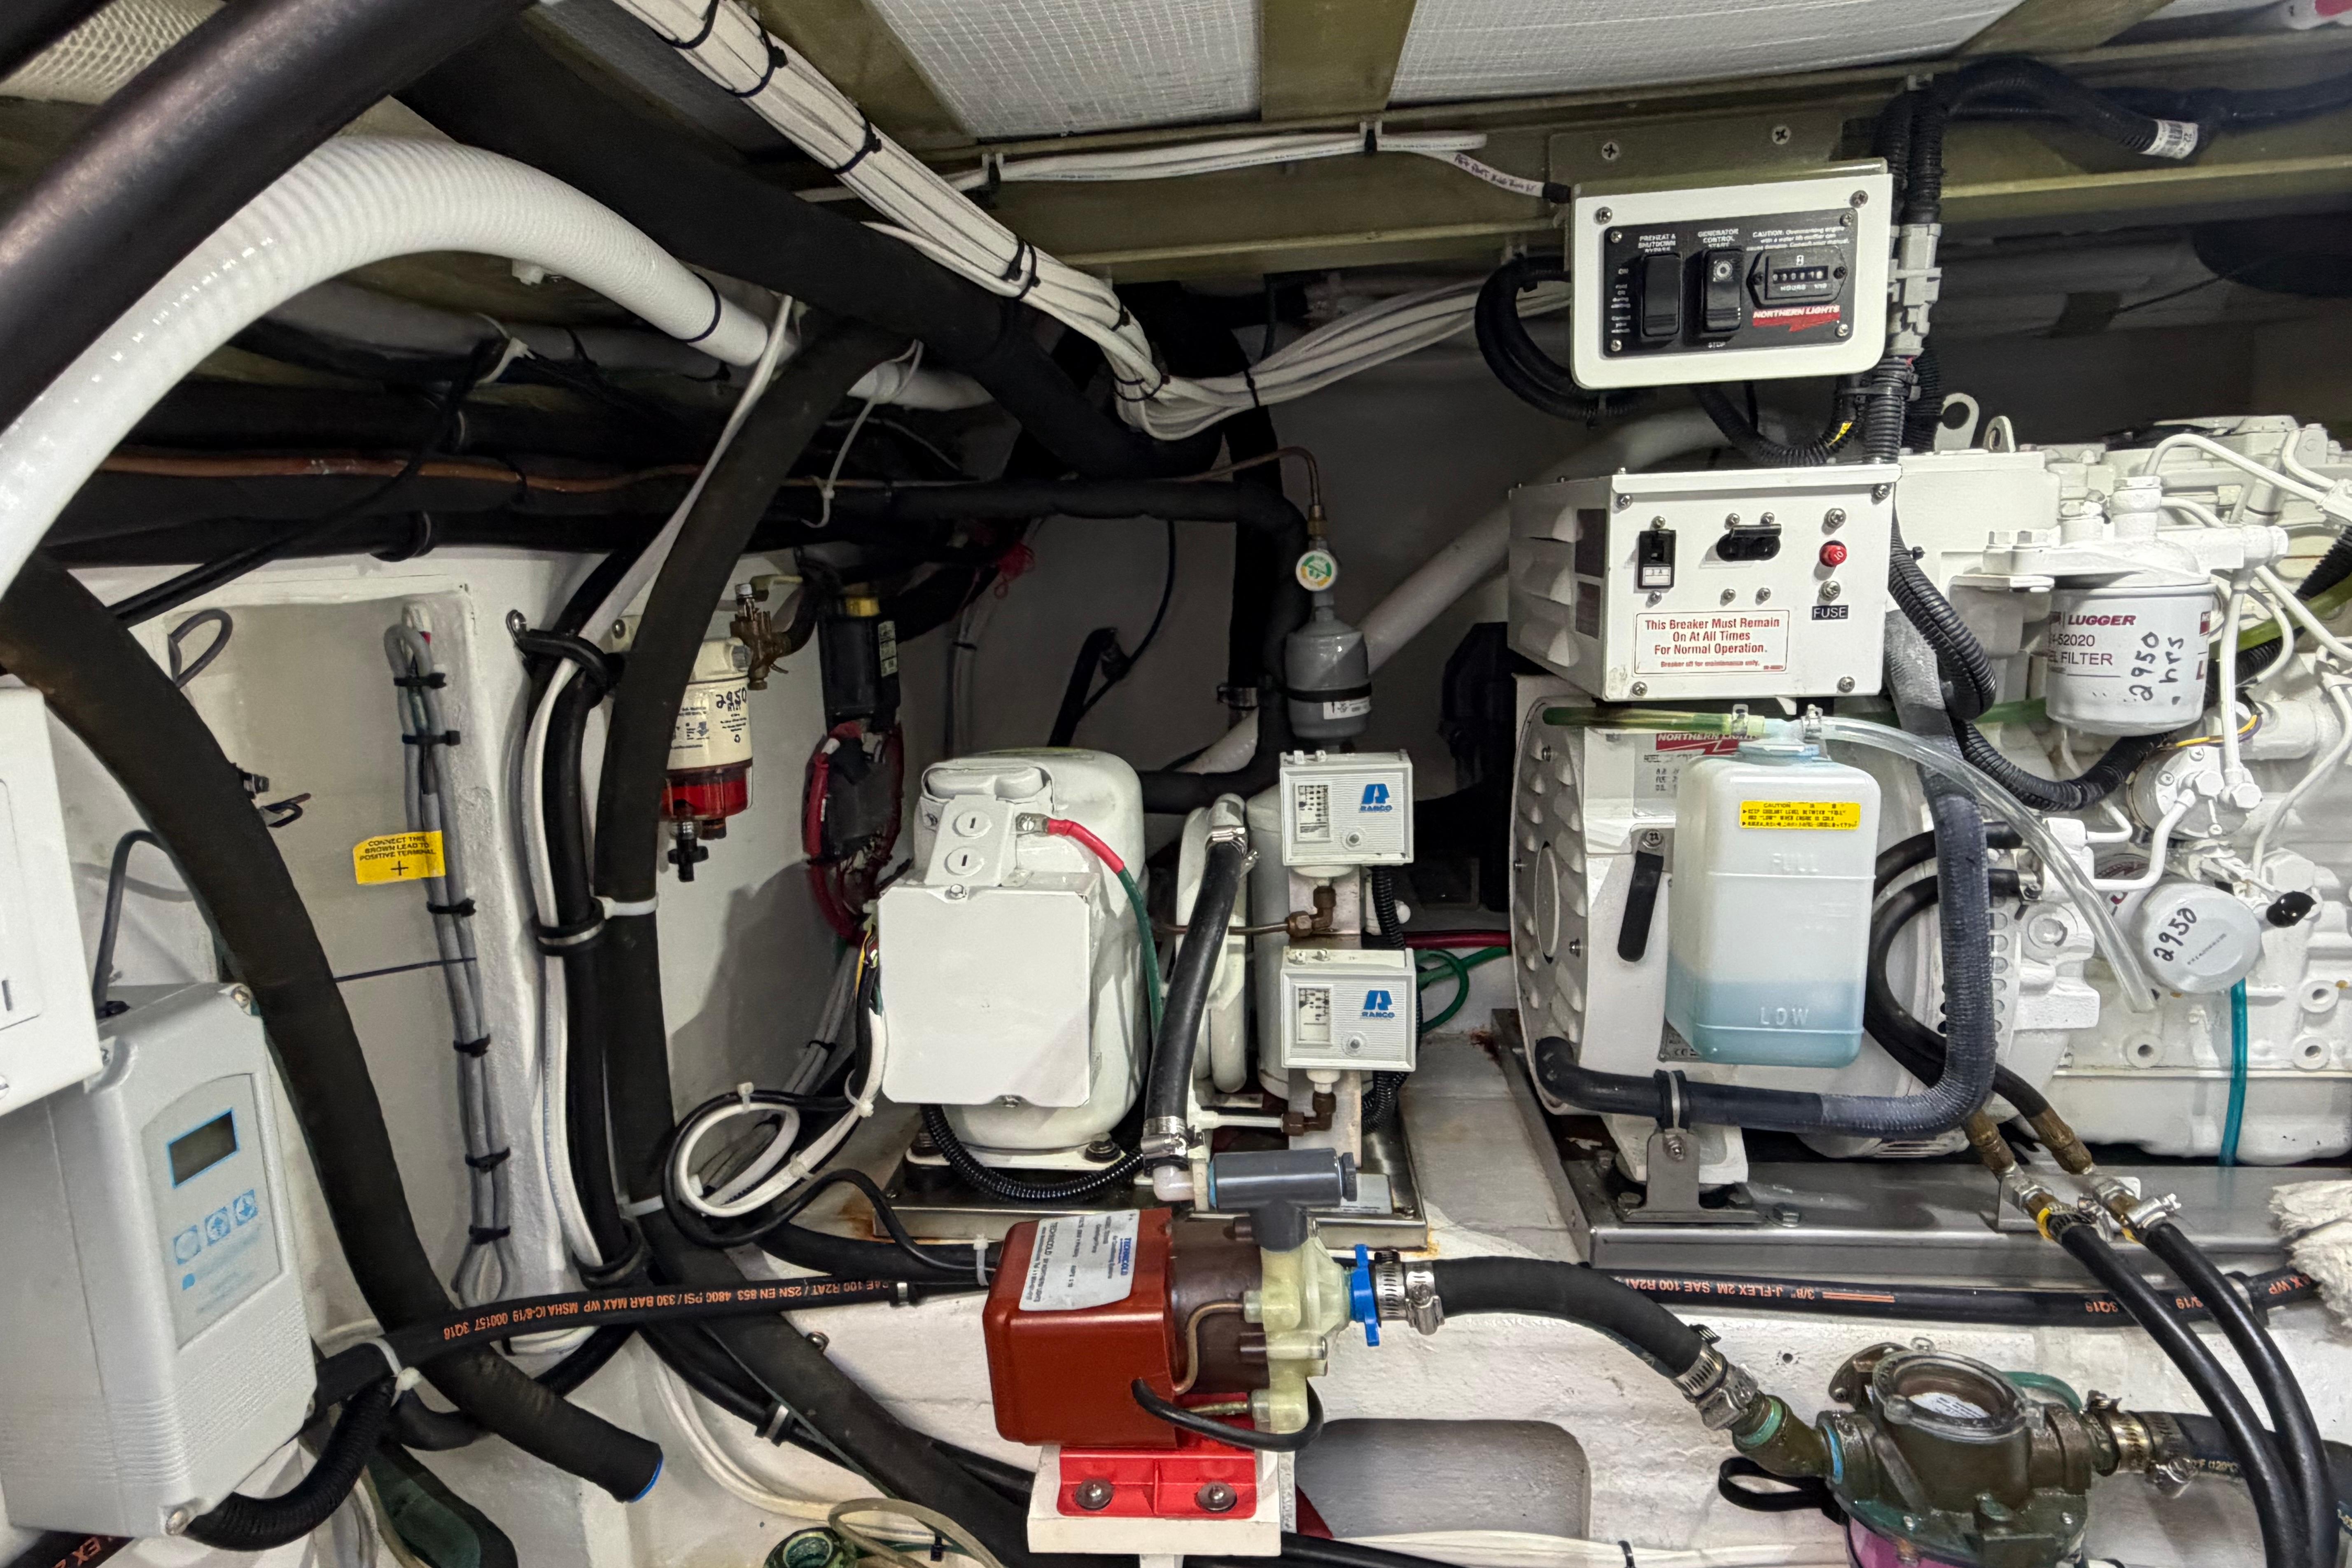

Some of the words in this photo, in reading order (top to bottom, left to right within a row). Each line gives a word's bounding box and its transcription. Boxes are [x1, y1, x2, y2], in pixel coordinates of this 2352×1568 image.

[1753, 308, 1805, 319] NORTHERN
[1805, 305, 1841, 315] LIGHTS
[1834, 551, 1844, 560] 10
[1813, 607, 1847, 618] FUSE
[1645, 620, 1666, 630] This
[1669, 619, 1709, 630] Breaker
[1712, 618, 1737, 629] Must
[1740, 617, 1780, 628] Remain
[2068, 614, 2137, 626] LUGGER
[1673, 631, 1687, 642] On
[1689, 631, 1700, 642] At
[1703, 630, 1717, 642] All
[1719, 630, 1751, 641] Times
[1654, 644, 1671, 655] For
[1674, 643, 1711, 655] Normal
[1714, 642, 1768, 656] Operation.
[2061, 651, 2113, 666] FILTER
[2159, 637, 2184, 684] hrs
[2129, 632, 2160, 702] 2950
[368, 836, 406, 847] CONNECT
[365, 845, 395, 854] BROWN
[359, 851, 396, 861] POSITIVE
[2154, 907, 2198, 962] 2950
[1760, 1007, 1810, 1026] LOW
[811, 1284, 840, 1296] R2AT
[843, 1281, 863, 1292] 100
[1659, 1279, 1680, 1290] 100
[1684, 1281, 1710, 1293] SAE
[1717, 1282, 1735, 1294] 2M
[1739, 1283, 1783, 1297] J-FLEX
[2268, 1280, 2292, 1295] WP
[738, 1290, 757, 1300] 853
[760, 1288, 775, 1298] EN
[779, 1287, 801, 1297] 2SN
[604, 1298, 627, 1309] MAX
[631, 1296, 653, 1308] BAR
[657, 1295, 674, 1306] 330
[685, 1294, 702, 1303] PSI
[548, 1303, 578, 1315] MSHA
[584, 1301, 600, 1311] WP
